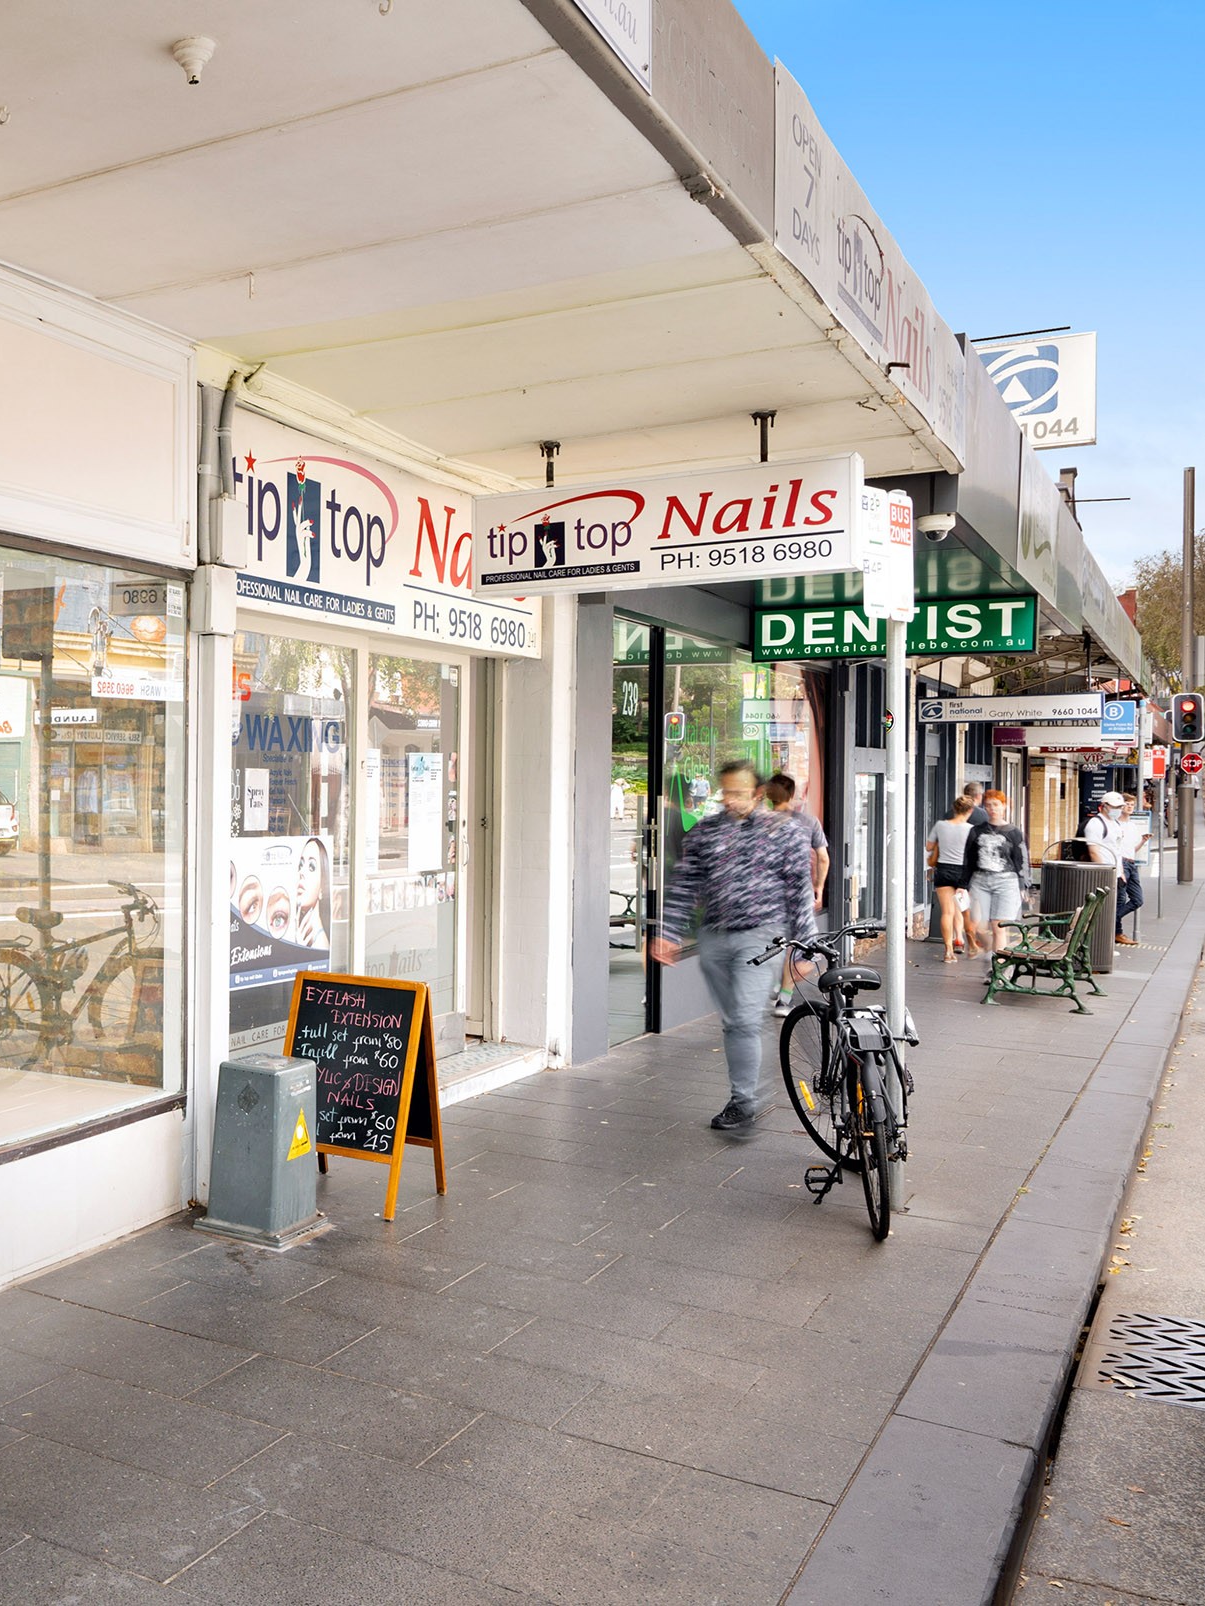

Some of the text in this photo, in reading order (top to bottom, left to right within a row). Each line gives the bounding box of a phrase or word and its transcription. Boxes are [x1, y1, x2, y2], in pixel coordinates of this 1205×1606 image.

[792, 113, 822, 178] OPEN
[803, 164, 816, 209] 7
[792, 207, 821, 266] DAYS
[864, 251, 883, 320] top
[1020, 417, 1079, 440] 1044
[487, 479, 838, 566] tip top Nails
[891, 506, 910, 525] BUS
[325, 488, 386, 586] top
[890, 527, 911, 543] ZONE
[660, 539, 833, 571] PH: 9518 6980
[485, 571, 532, 583] PROFESSIONAL
[533, 570, 547, 578] NAIL
[548, 568, 566, 577] CARE
[567, 567, 581, 575] FOR
[581, 564, 605, 574] LADIES
[612, 562, 635, 572] GENTS
[236, 578, 395, 622] OFESSIONAL NAIL CARE FOR LADIES & GENTS
[413, 600, 525, 648] PH: 9518 6980
[761, 601, 1026, 647] DENIST
[762, 637, 1026, 656] www.dentalcarlebe.com.au
[622, 681, 639, 716] 239
[949, 707, 982, 715] national
[989, 709, 1014, 718] Garry
[1016, 709, 1042, 717] White
[1051, 708, 1074, 716] 9660
[1077, 707, 1098, 715] 1044
[245, 713, 340, 753] WAXING
[1183, 759, 1202, 768] STOP
[230, 944, 272, 967] Extensions
[305, 987, 366, 1009] EYELASH
[331, 1009, 402, 1029] EXTENSION
[231, 1025, 285, 1047] NAIL CARE FOR
[332, 1028, 348, 1042] set
[352, 1035, 382, 1053] from
[343, 1054, 369, 1069] from
[317, 1066, 342, 1084] YLIC
[353, 1071, 401, 1097] DESIGN
[319, 1107, 338, 1122] set
[337, 1116, 367, 1131] from
